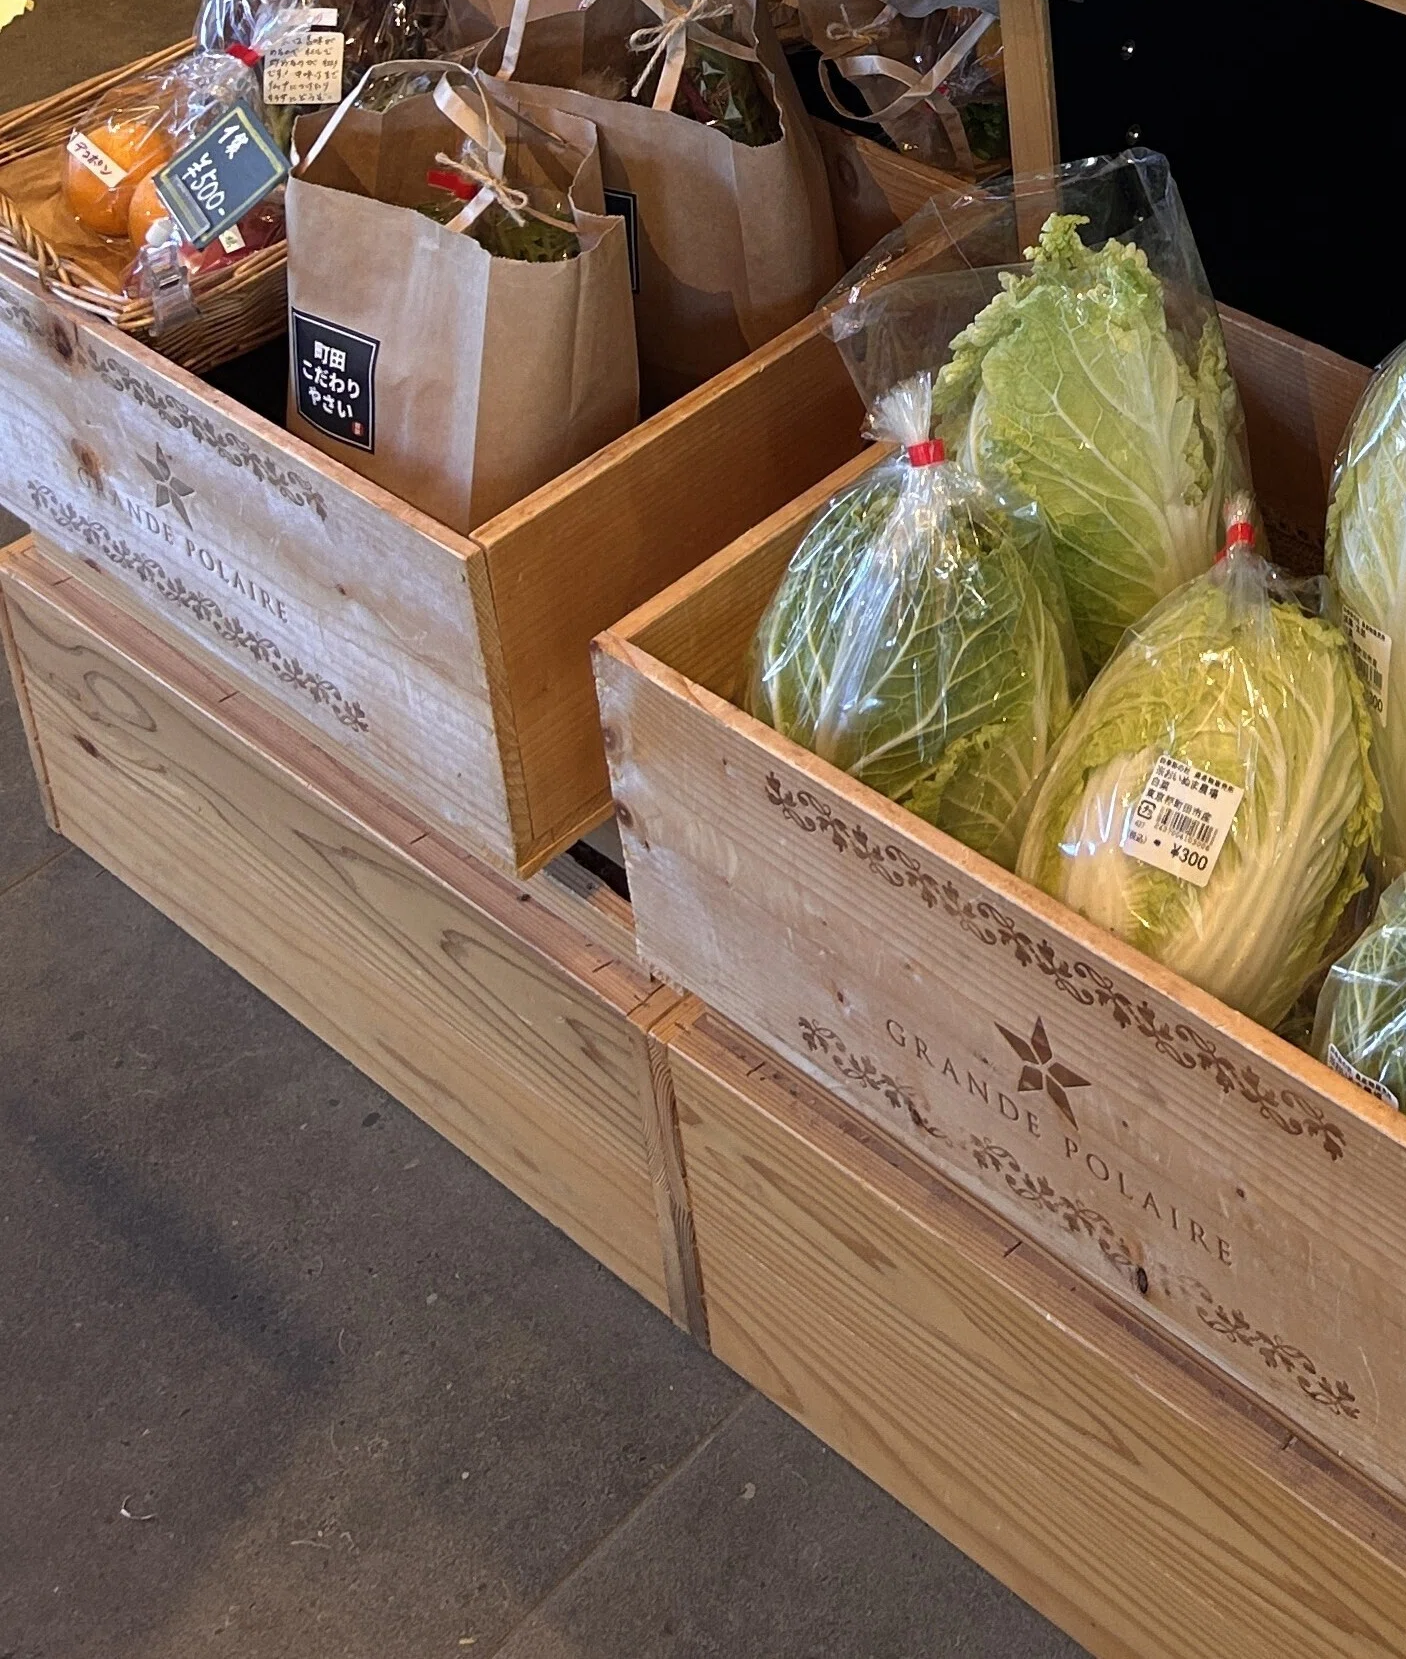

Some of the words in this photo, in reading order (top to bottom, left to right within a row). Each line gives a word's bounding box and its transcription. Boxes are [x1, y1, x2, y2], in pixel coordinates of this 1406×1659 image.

[314, 340, 346, 372] 町田
[302, 359, 360, 400] こだわり
[308, 386, 354, 418] やさい
[1170, 842, 1209, 871] ¥300
[885, 1018, 1041, 1139] GRANDE
[1063, 1135, 1235, 1269] POLAIRE
